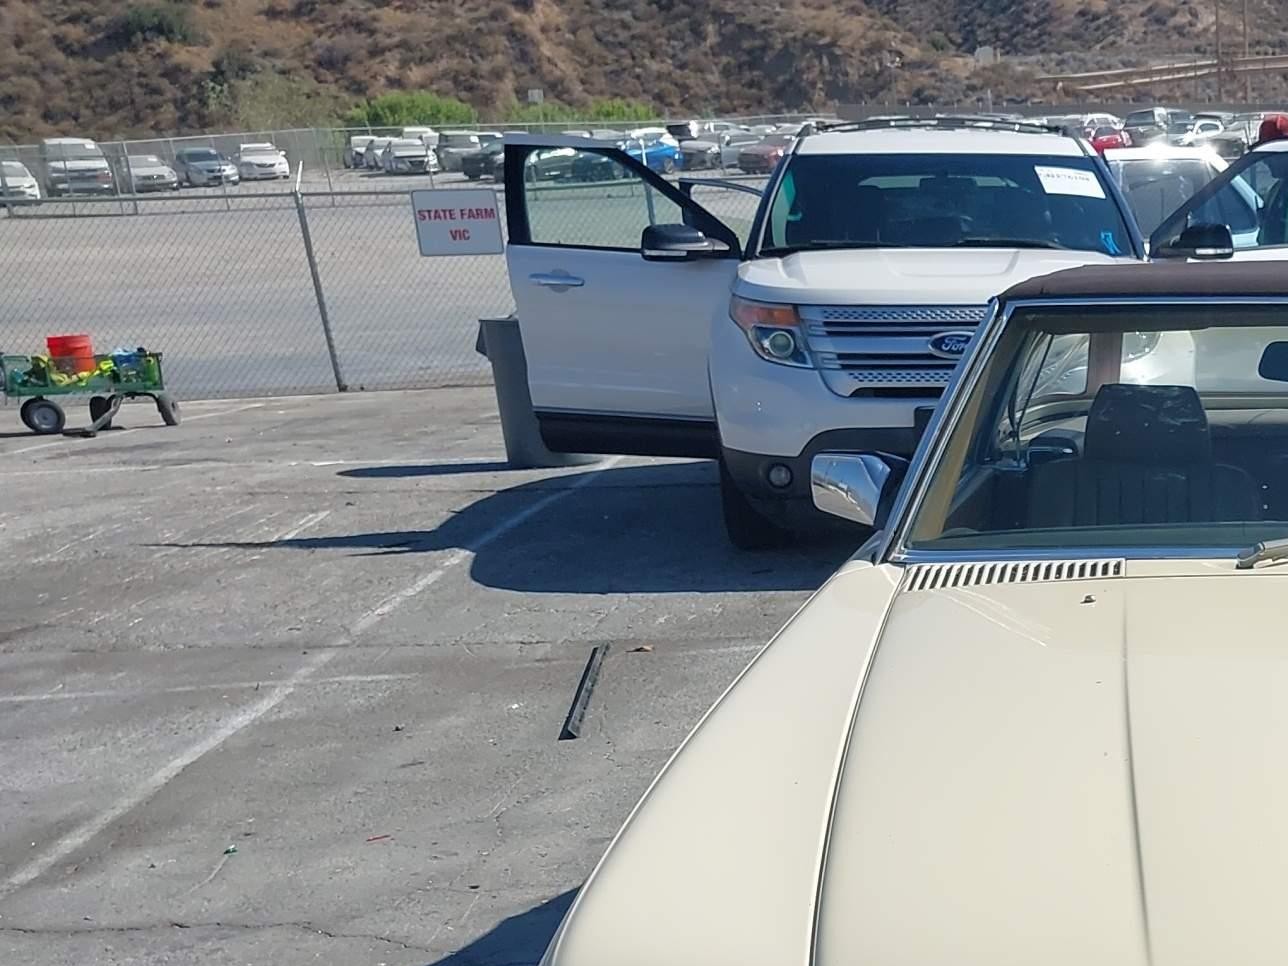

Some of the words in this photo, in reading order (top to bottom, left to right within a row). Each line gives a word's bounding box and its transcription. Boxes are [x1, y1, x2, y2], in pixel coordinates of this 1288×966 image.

[417, 209, 456, 221] STATE
[460, 207, 496, 219] FARM
[449, 229, 471, 241] VIC
